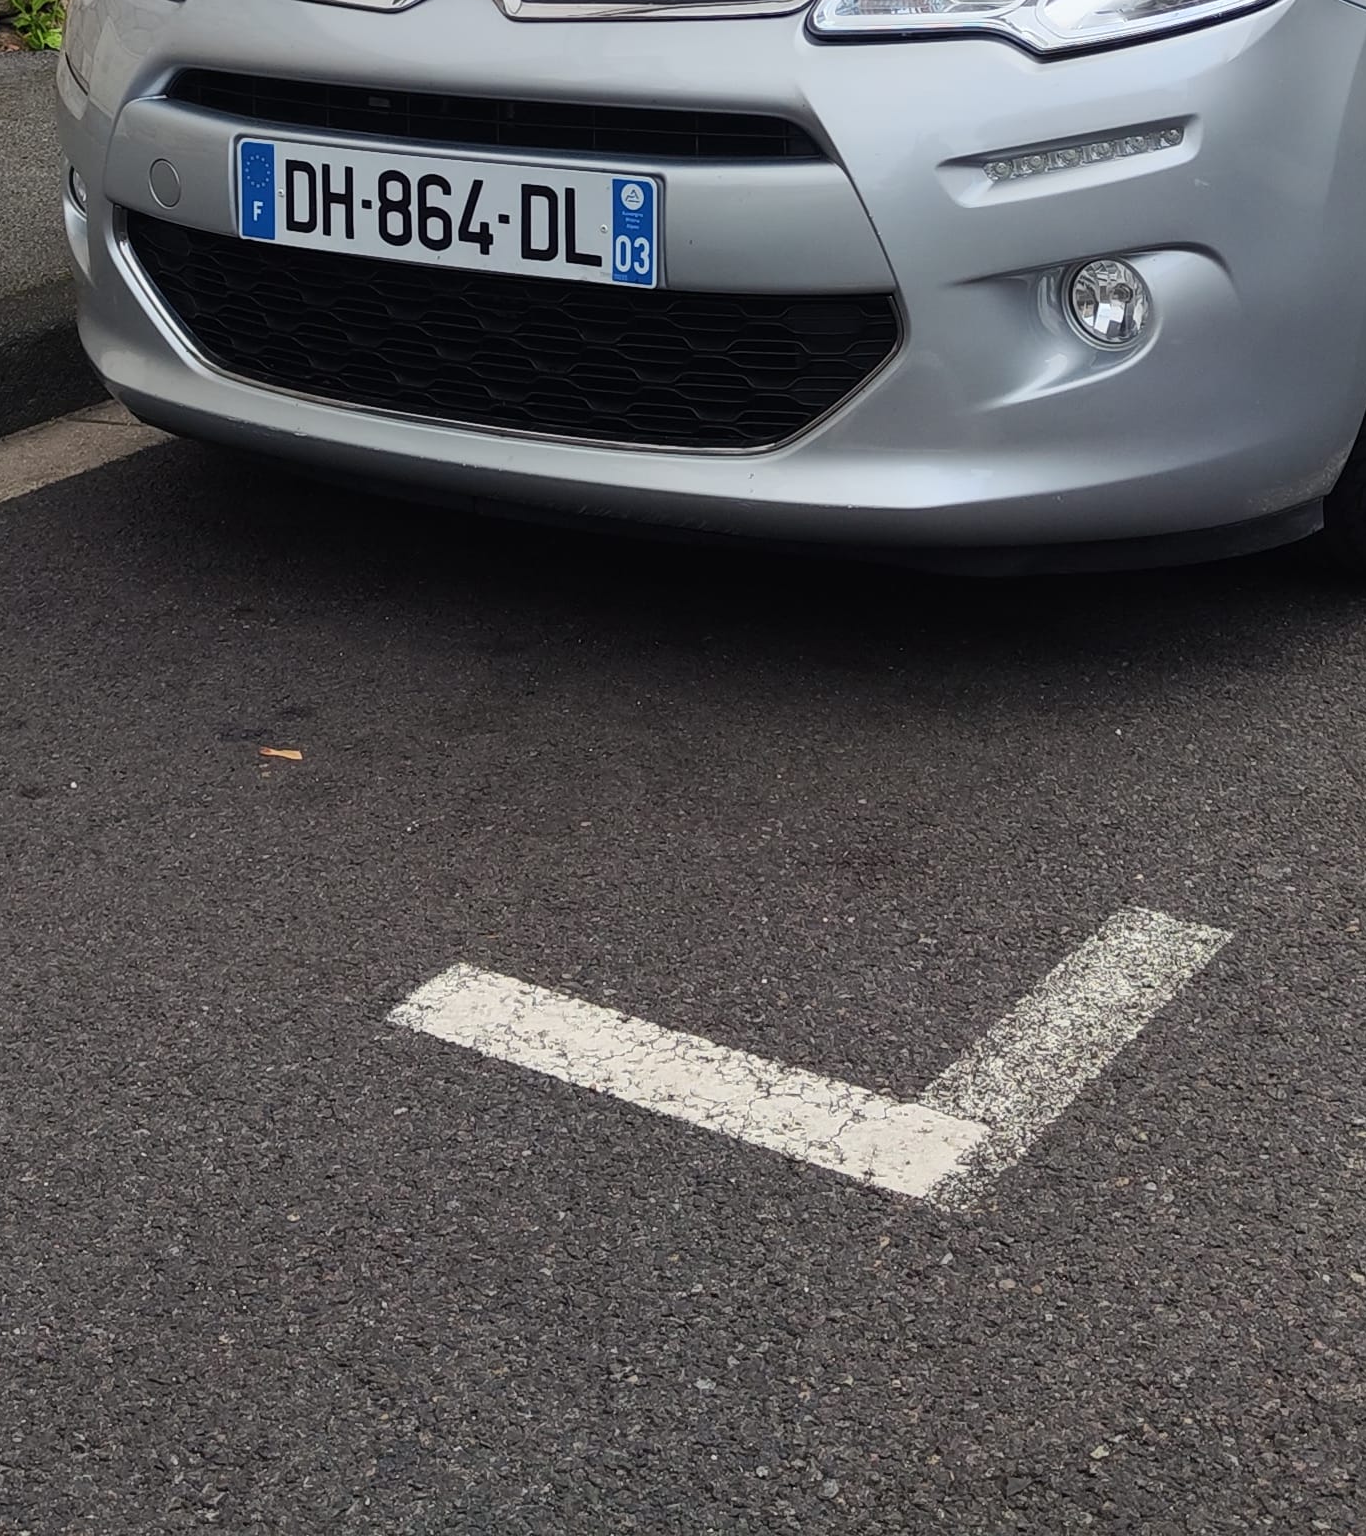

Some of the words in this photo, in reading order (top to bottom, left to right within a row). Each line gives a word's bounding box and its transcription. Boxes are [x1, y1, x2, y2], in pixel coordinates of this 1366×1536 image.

[253, 200, 263, 221] F
[285, 159, 603, 267] DH-864-DL
[615, 235, 651, 275] 03
